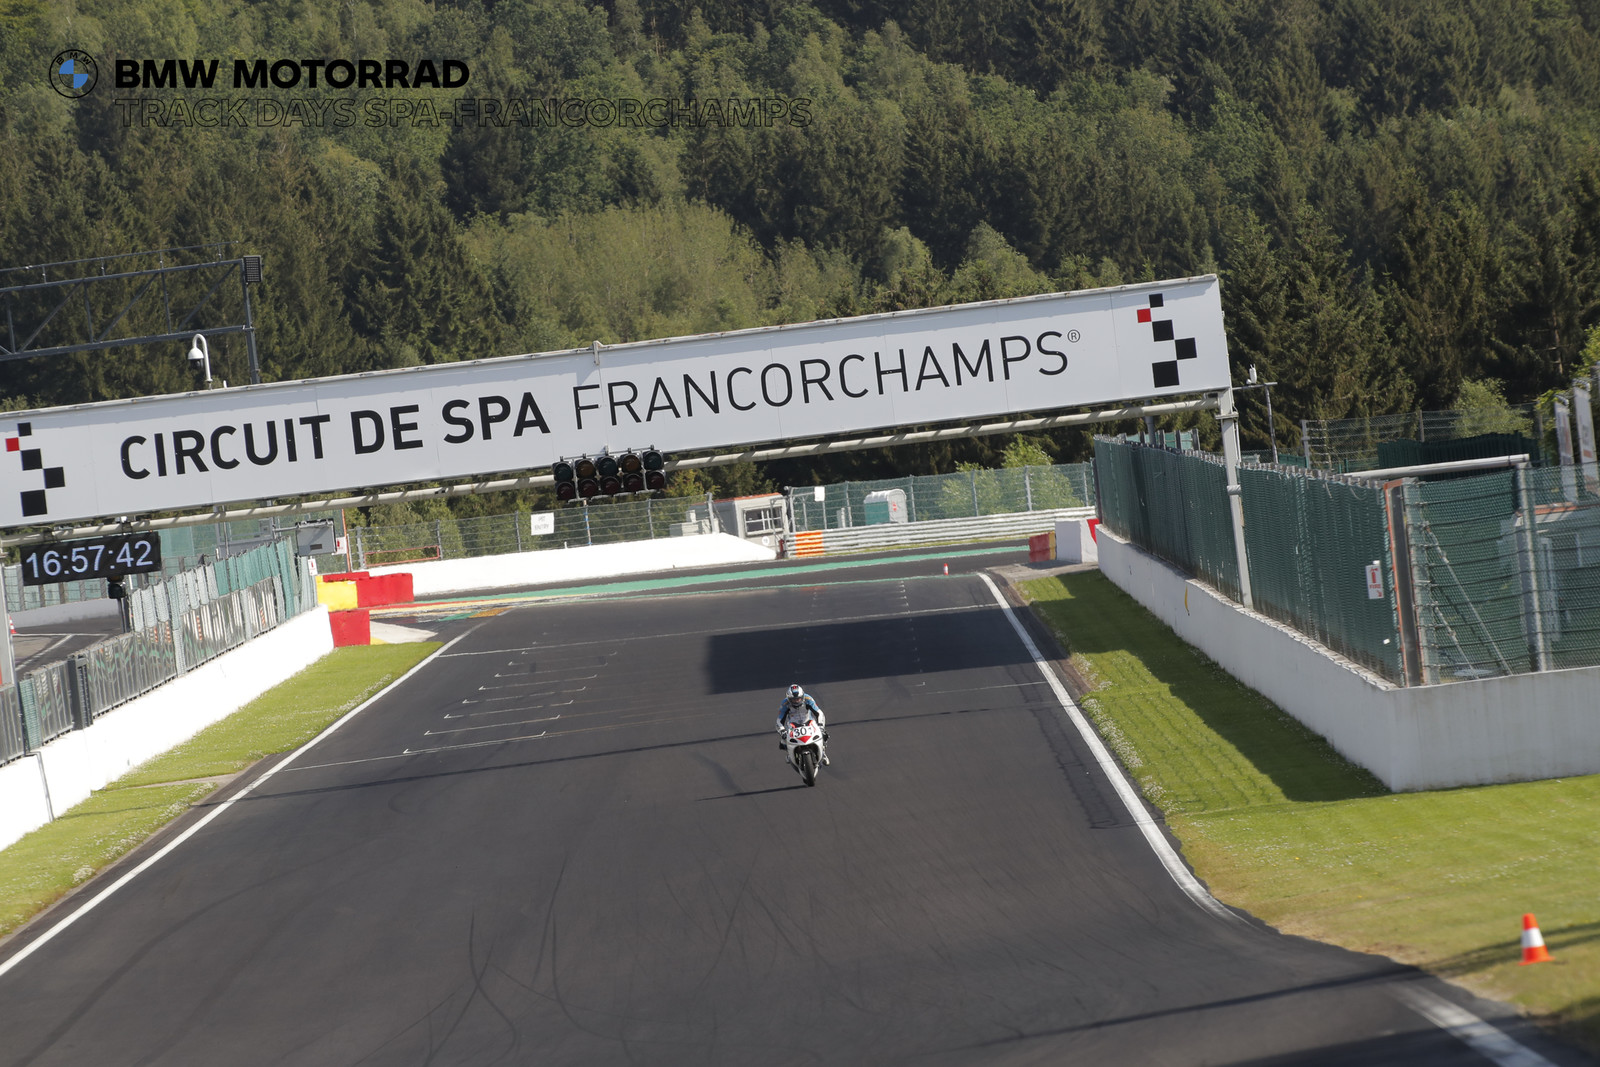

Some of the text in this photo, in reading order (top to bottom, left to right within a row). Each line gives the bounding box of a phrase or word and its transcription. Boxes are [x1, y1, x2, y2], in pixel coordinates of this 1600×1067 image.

[120, 414, 331, 480] CIRCUIT
[350, 404, 424, 455] DE
[441, 391, 551, 444] SPA
[26, 540, 153, 578] 16:57:42
